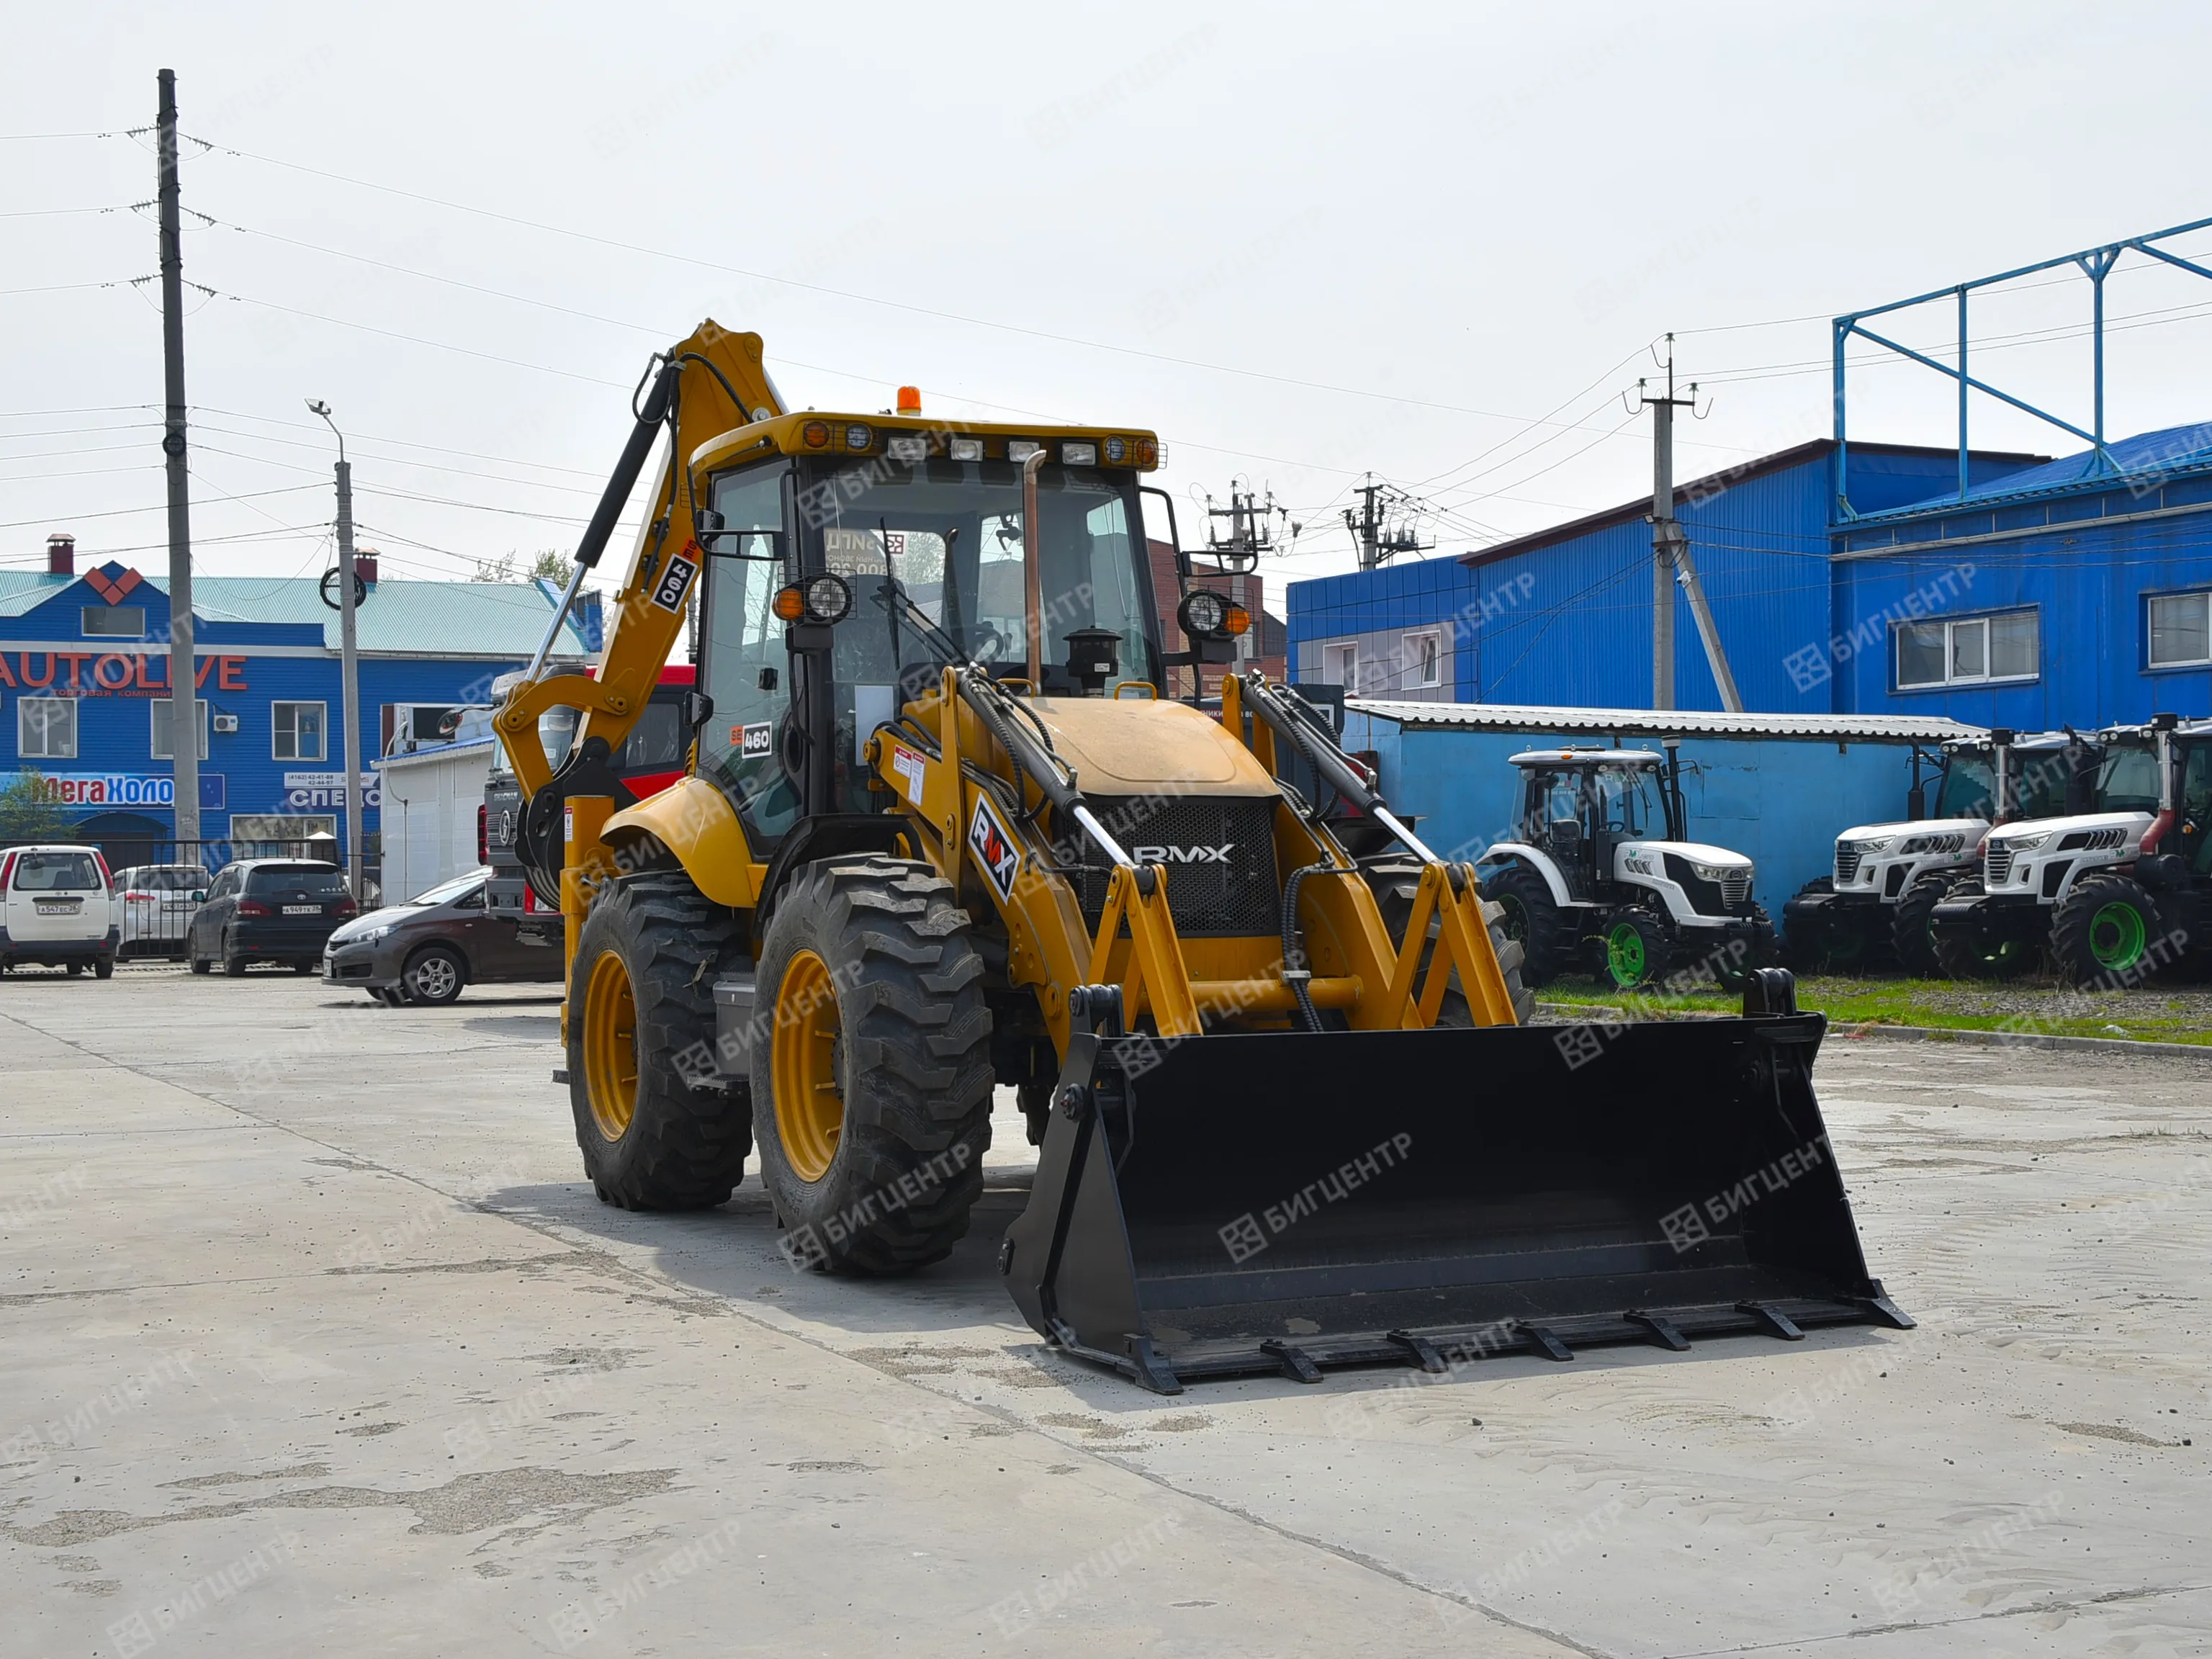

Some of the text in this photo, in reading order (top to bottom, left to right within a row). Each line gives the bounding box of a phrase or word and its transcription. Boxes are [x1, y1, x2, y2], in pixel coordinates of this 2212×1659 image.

[661, 564, 688, 603] 460
[745, 730, 769, 750] 460
[32, 776, 174, 805] МегаХоло
[974, 809, 1015, 887] RMX
[1133, 843, 1236, 864] RMX
